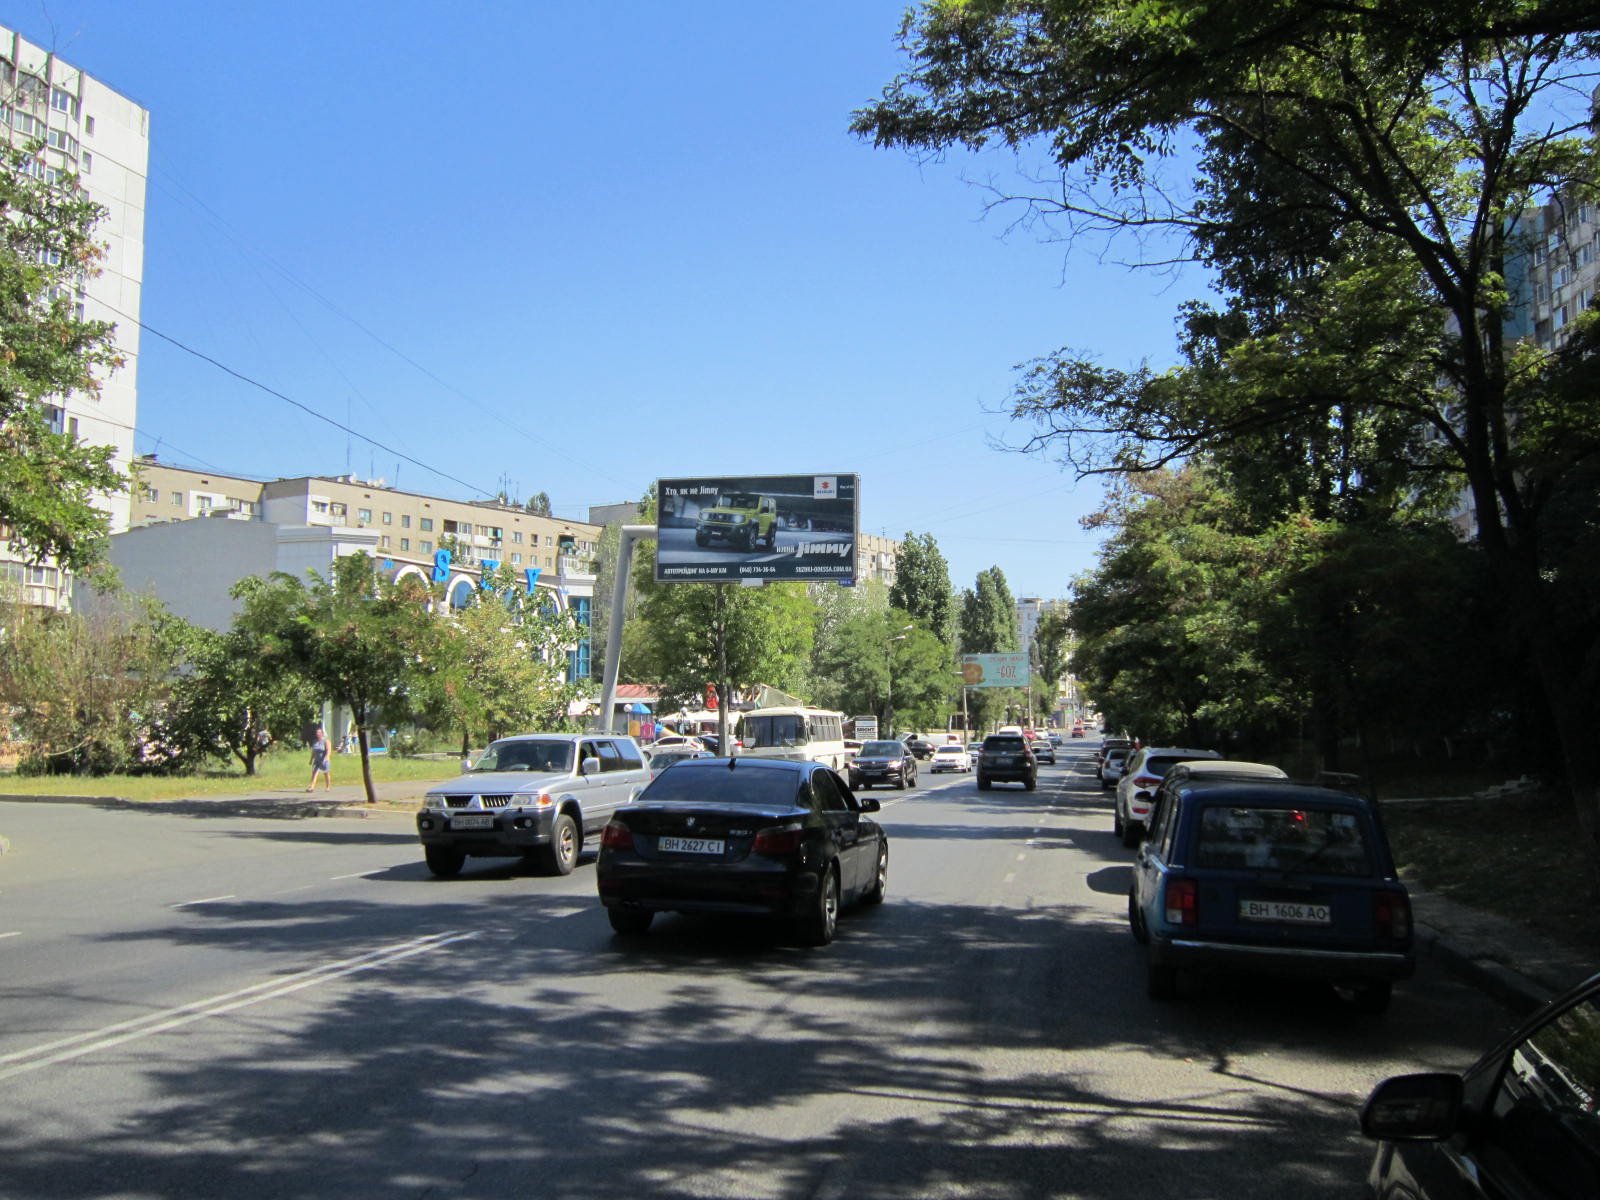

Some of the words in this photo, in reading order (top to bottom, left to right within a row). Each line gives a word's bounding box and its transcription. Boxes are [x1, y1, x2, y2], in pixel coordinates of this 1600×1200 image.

[700, 486, 718, 495] Jimny
[664, 839, 679, 850] BH
[681, 840, 705, 852] 2627
[1249, 903, 1269, 916] BH
[1274, 905, 1303, 918] 1606
[1308, 907, 1326, 919] AO
